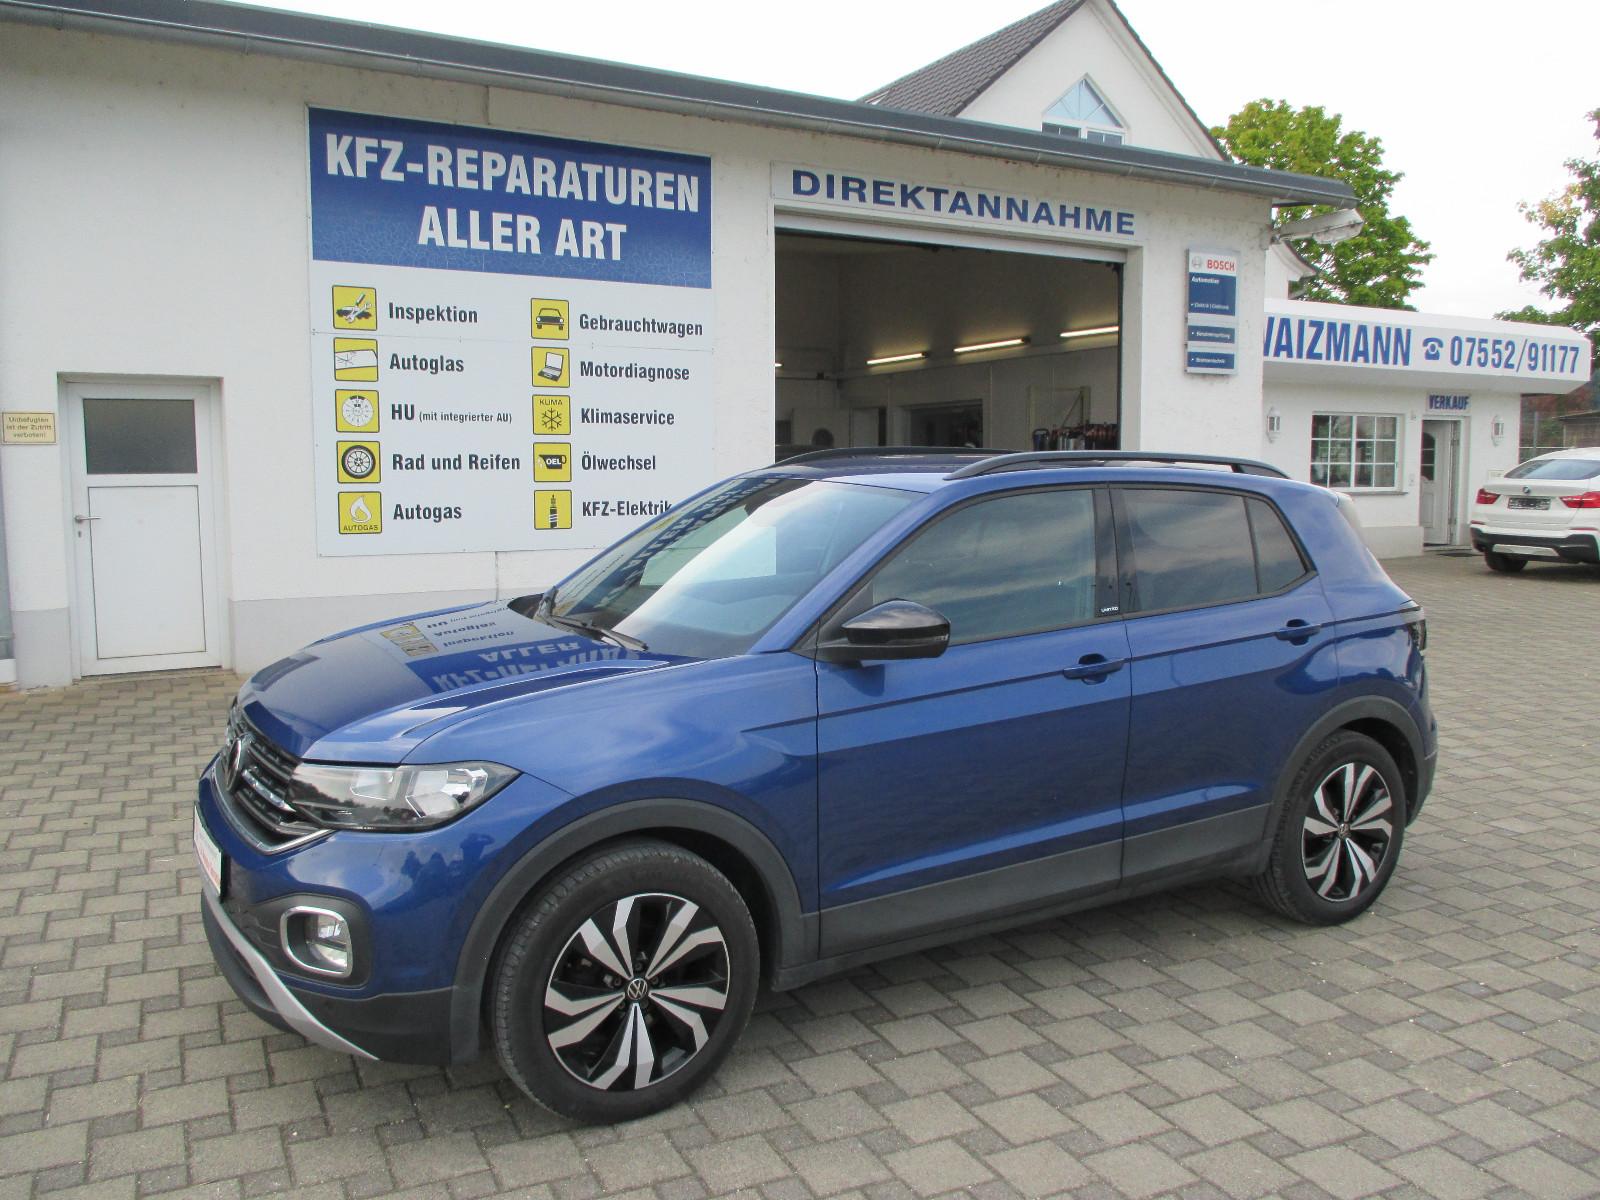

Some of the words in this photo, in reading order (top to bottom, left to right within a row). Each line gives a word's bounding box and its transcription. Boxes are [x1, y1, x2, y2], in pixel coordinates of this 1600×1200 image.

[326, 133, 699, 213] KFZ-REPARATUREN
[792, 169, 1135, 236] DIREKTANNAHME
[417, 206, 541, 254] ALLER
[554, 218, 627, 261] ART
[1207, 259, 1236, 271] BOSCH
[388, 302, 478, 324] Inspektion
[579, 313, 703, 338] Gebrauchtwagen
[389, 353, 465, 375] Autoglas
[1450, 335, 1580, 374] 07552/91177
[580, 361, 690, 382] Motordiagnose
[1428, 394, 1470, 411] VERKAUF
[391, 403, 415, 421] HU
[419, 411, 438, 423] (mit
[440, 412, 494, 424] integrierter
[496, 412, 512, 424] AU)
[581, 408, 675, 425] Klimaservice
[392, 454, 425, 470] Rad
[431, 454, 462, 470] und
[468, 453, 521, 471] Reifen
[581, 451, 656, 470] Ölwechsel
[393, 504, 462, 522] Autogas
[582, 501, 673, 517] KFZ-Elektrik
[343, 524, 379, 532] AUTOGAS
